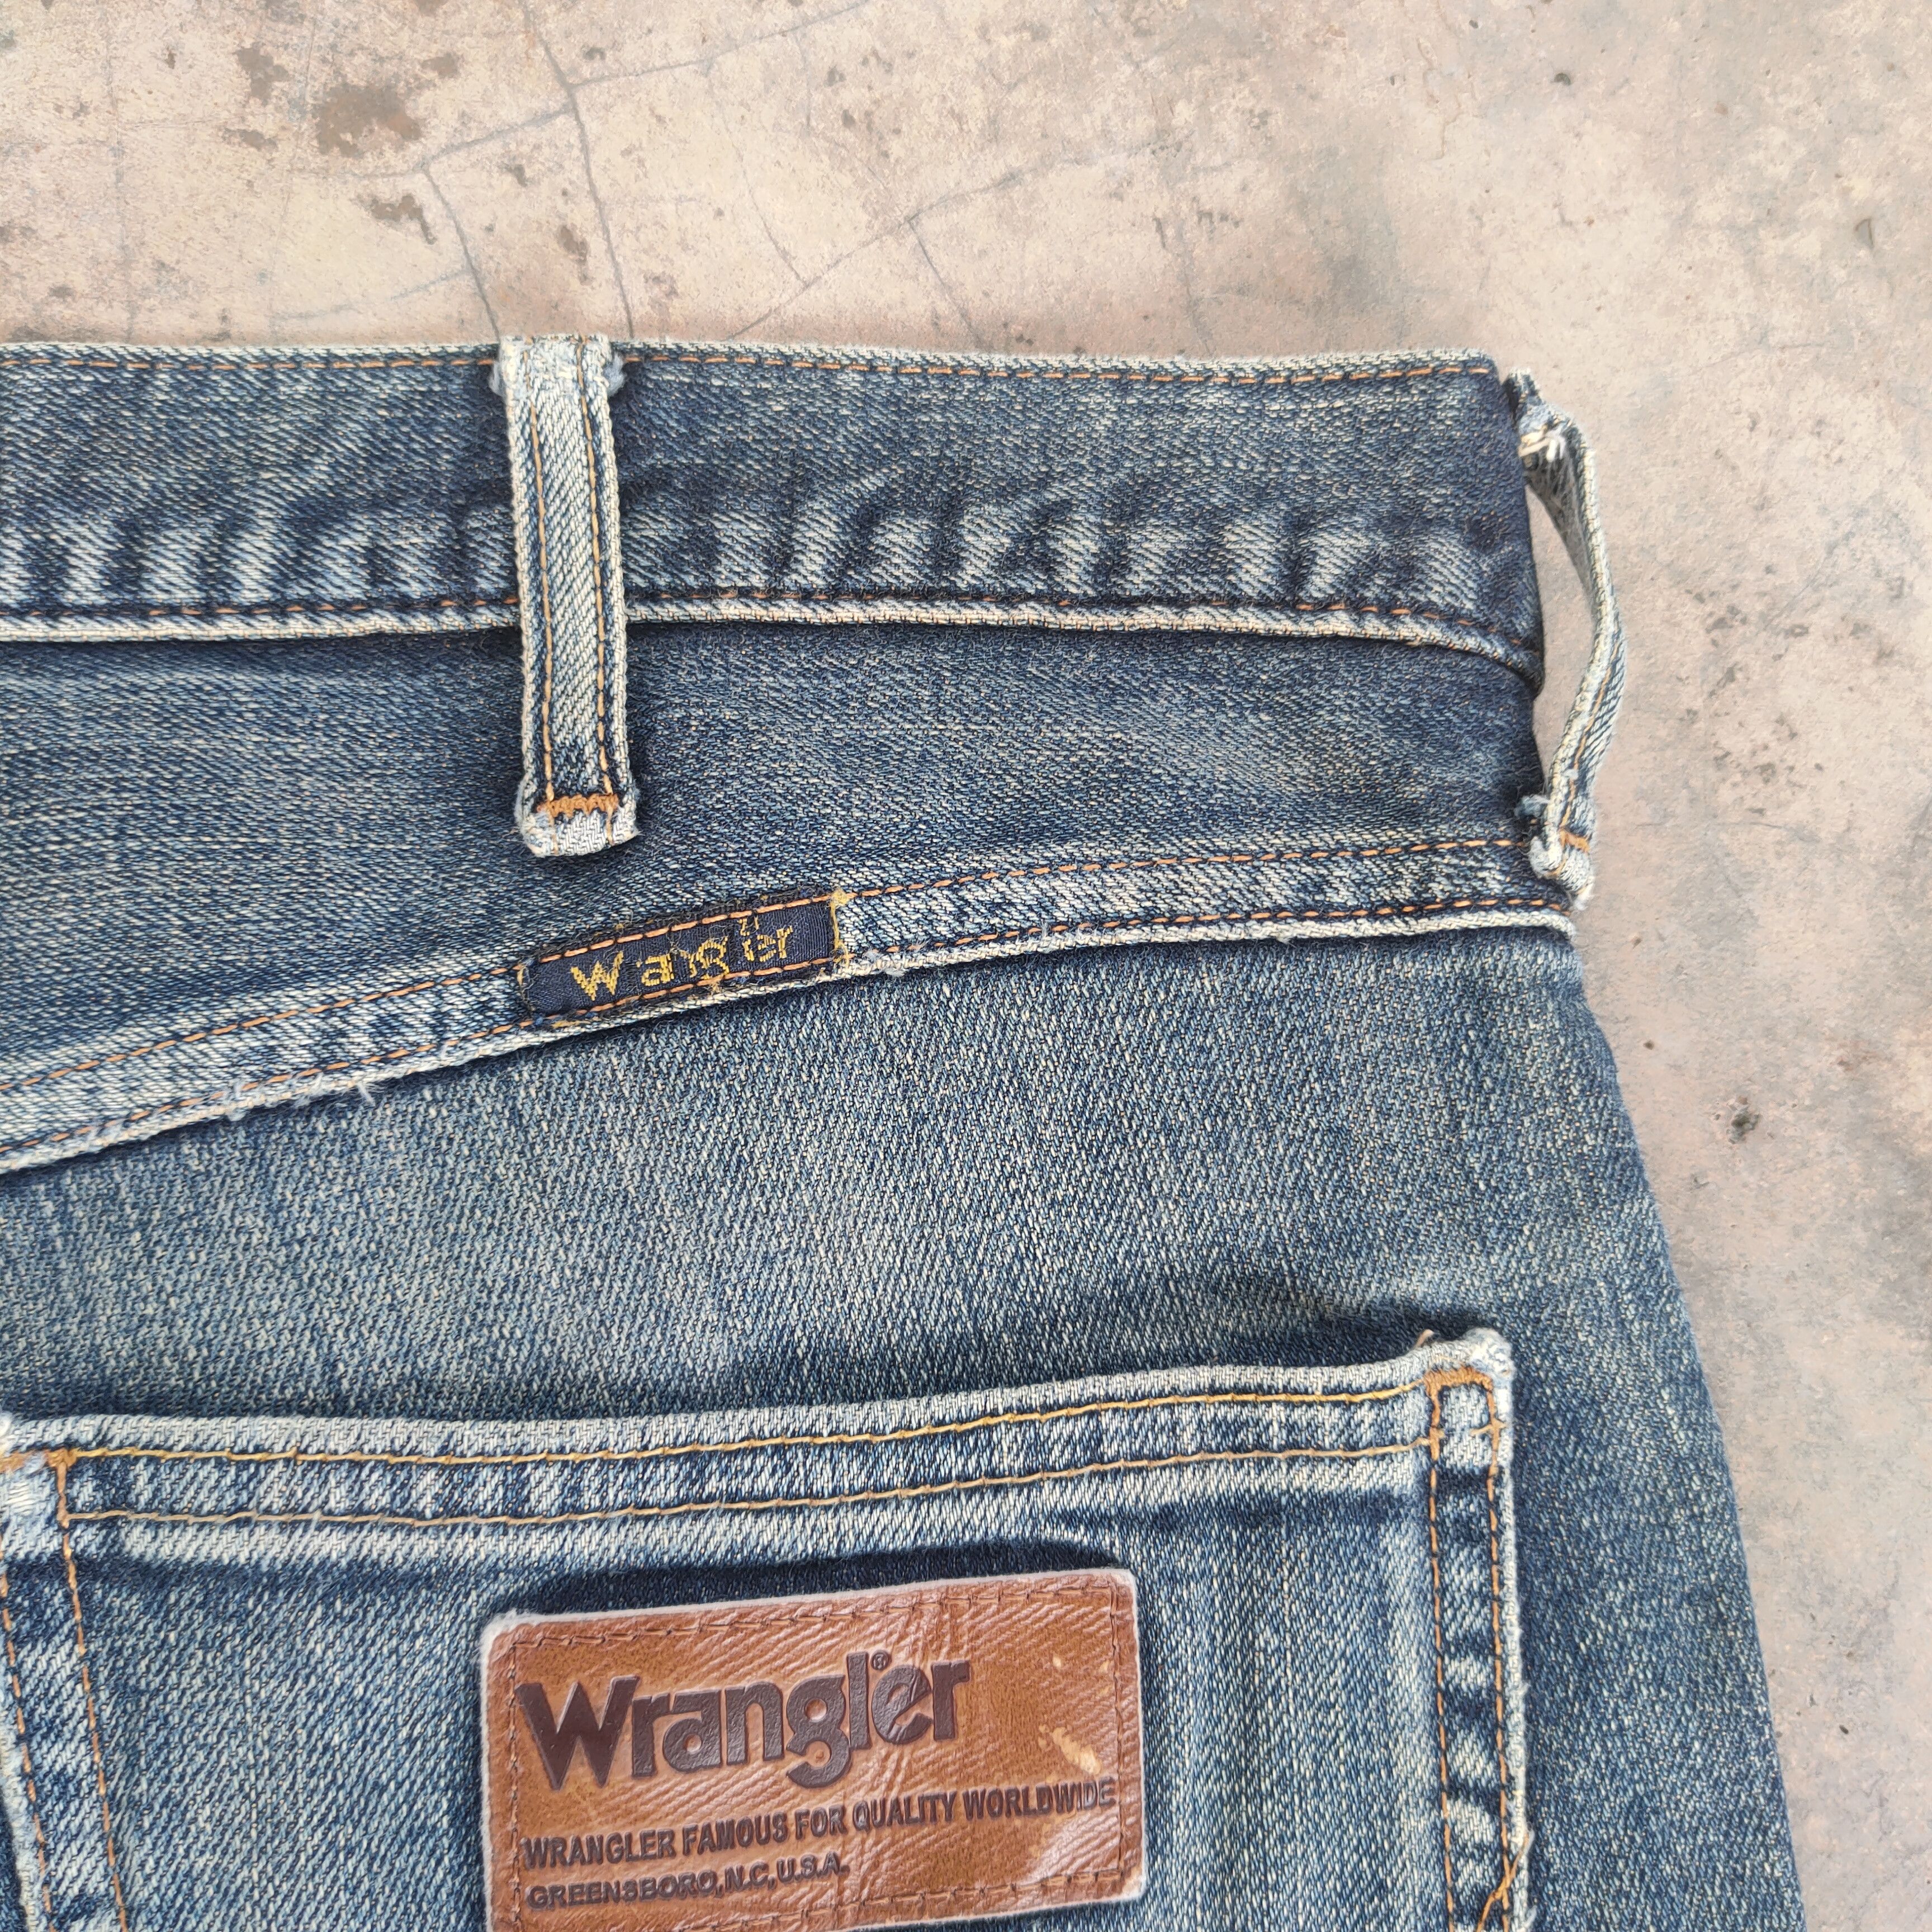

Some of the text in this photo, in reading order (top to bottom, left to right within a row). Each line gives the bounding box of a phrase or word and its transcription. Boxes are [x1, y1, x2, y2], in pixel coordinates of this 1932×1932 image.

[570, 916, 793, 1001] Wangler
[514, 1652, 970, 1789] Wrangler
[520, 1775, 1117, 1869] WRANGLER FAMOUS FOR QUALITY WORLDWIDE
